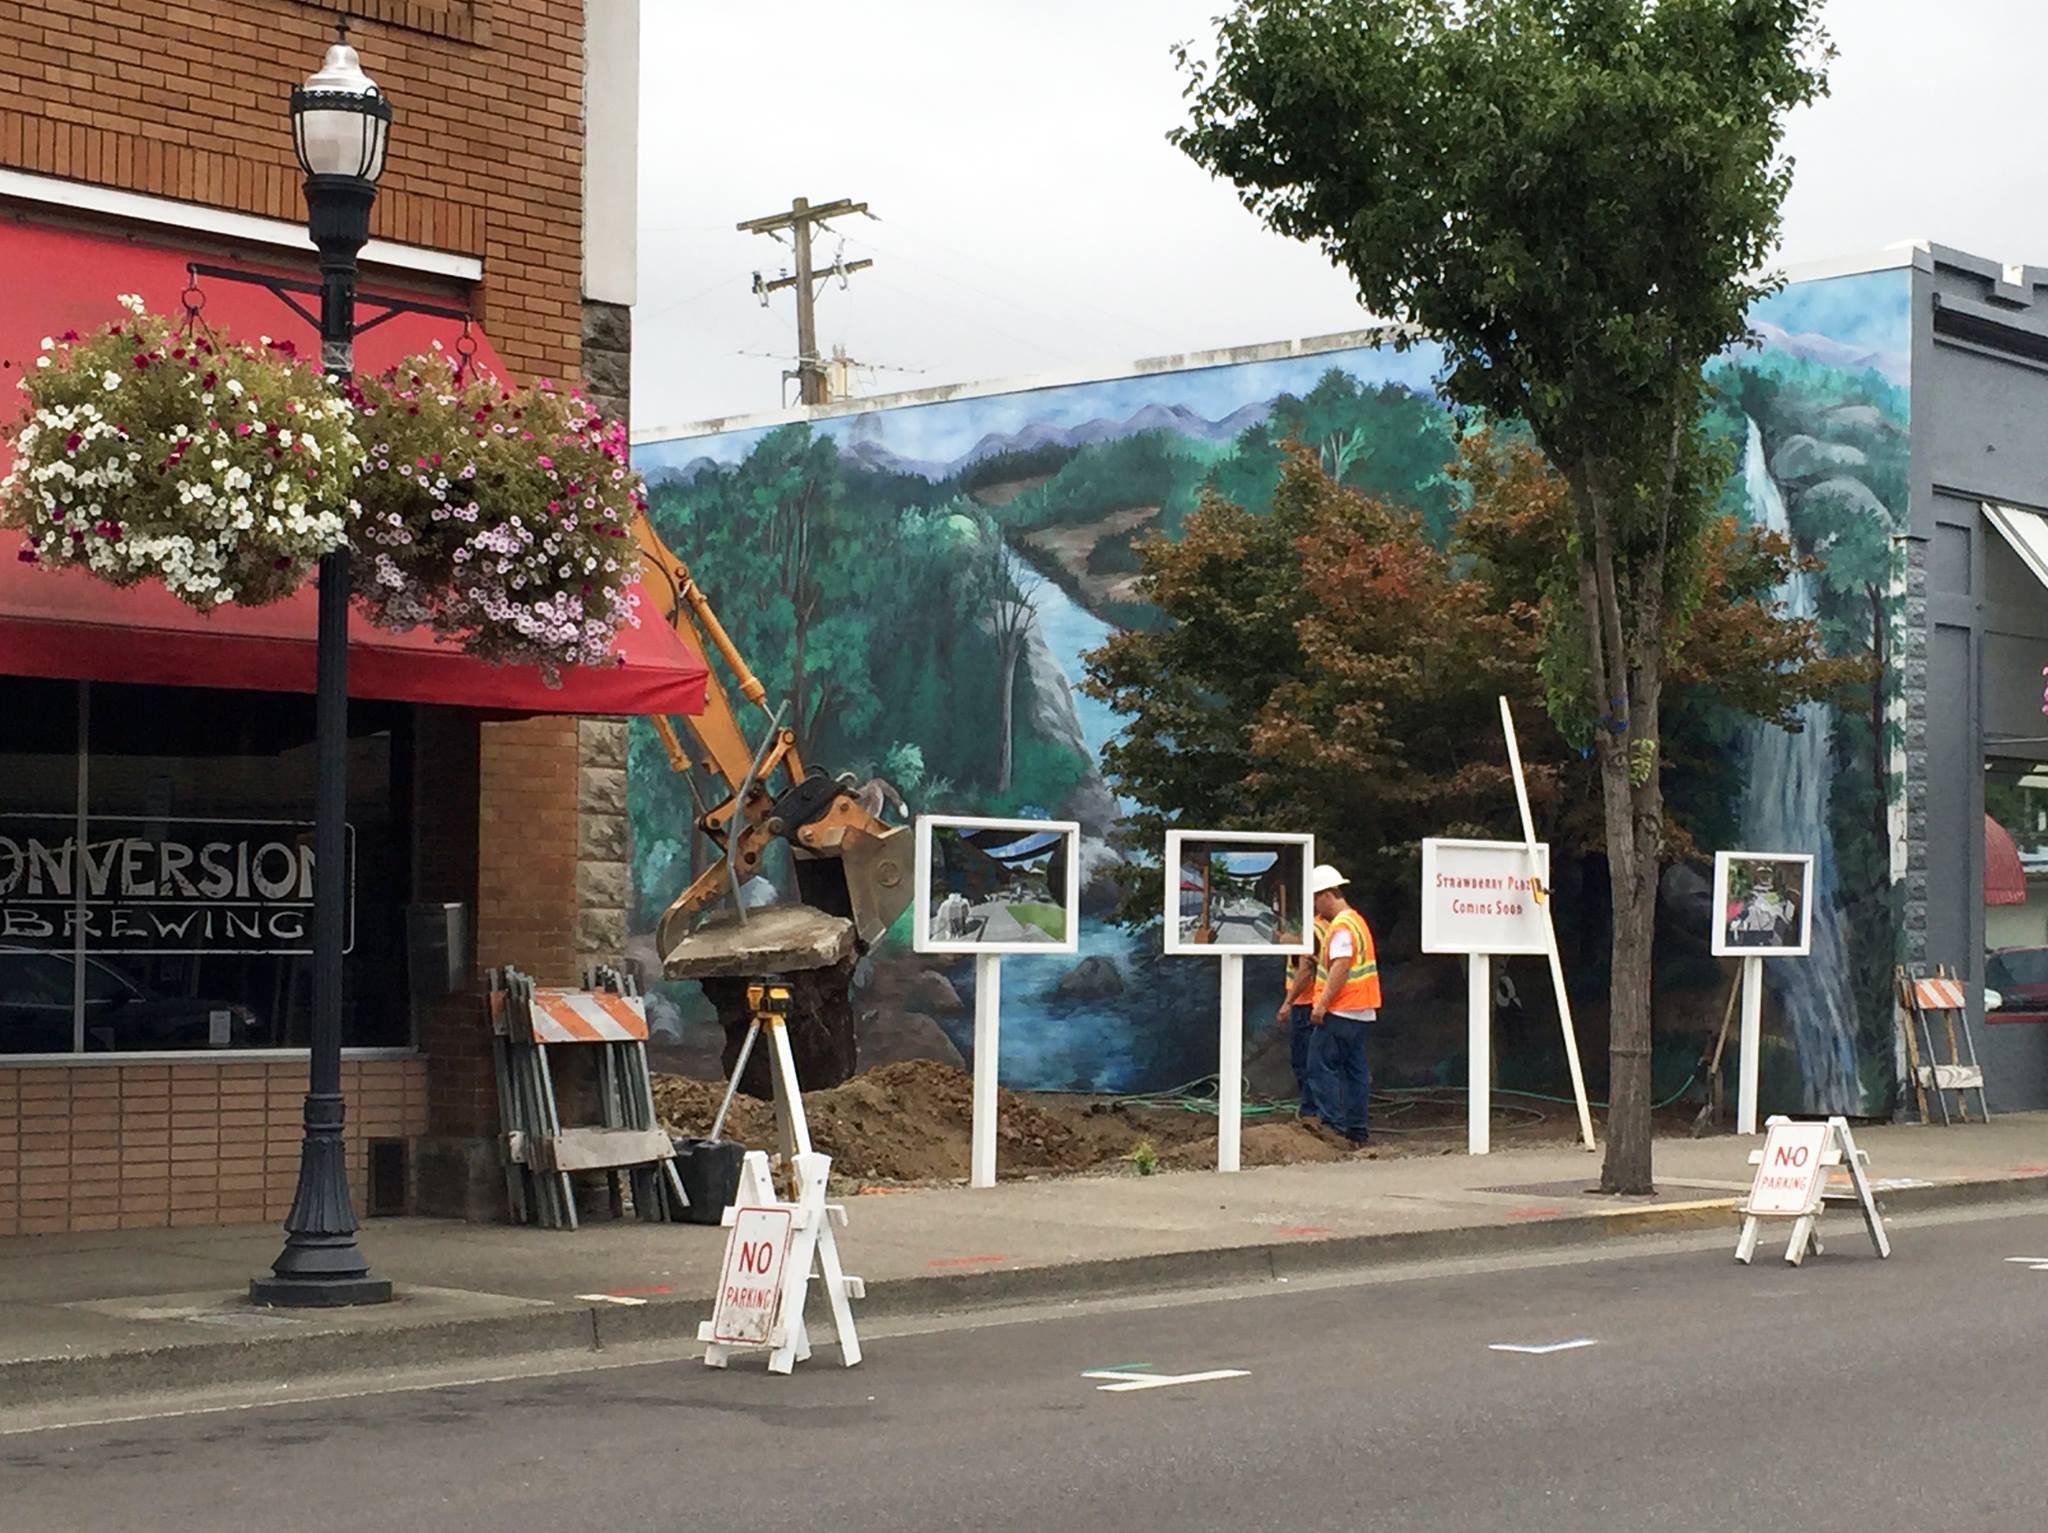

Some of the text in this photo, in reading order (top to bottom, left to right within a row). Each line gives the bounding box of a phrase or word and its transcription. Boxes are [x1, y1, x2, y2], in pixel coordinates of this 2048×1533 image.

[1507, 876, 1531, 891] Plaz
[1, 909, 304, 939] BREWING
[1774, 1146, 1809, 1167] NO
[1762, 1176, 1808, 1190] PARKING
[738, 1242, 773, 1275] NO
[726, 1286, 772, 1308] PARKING
